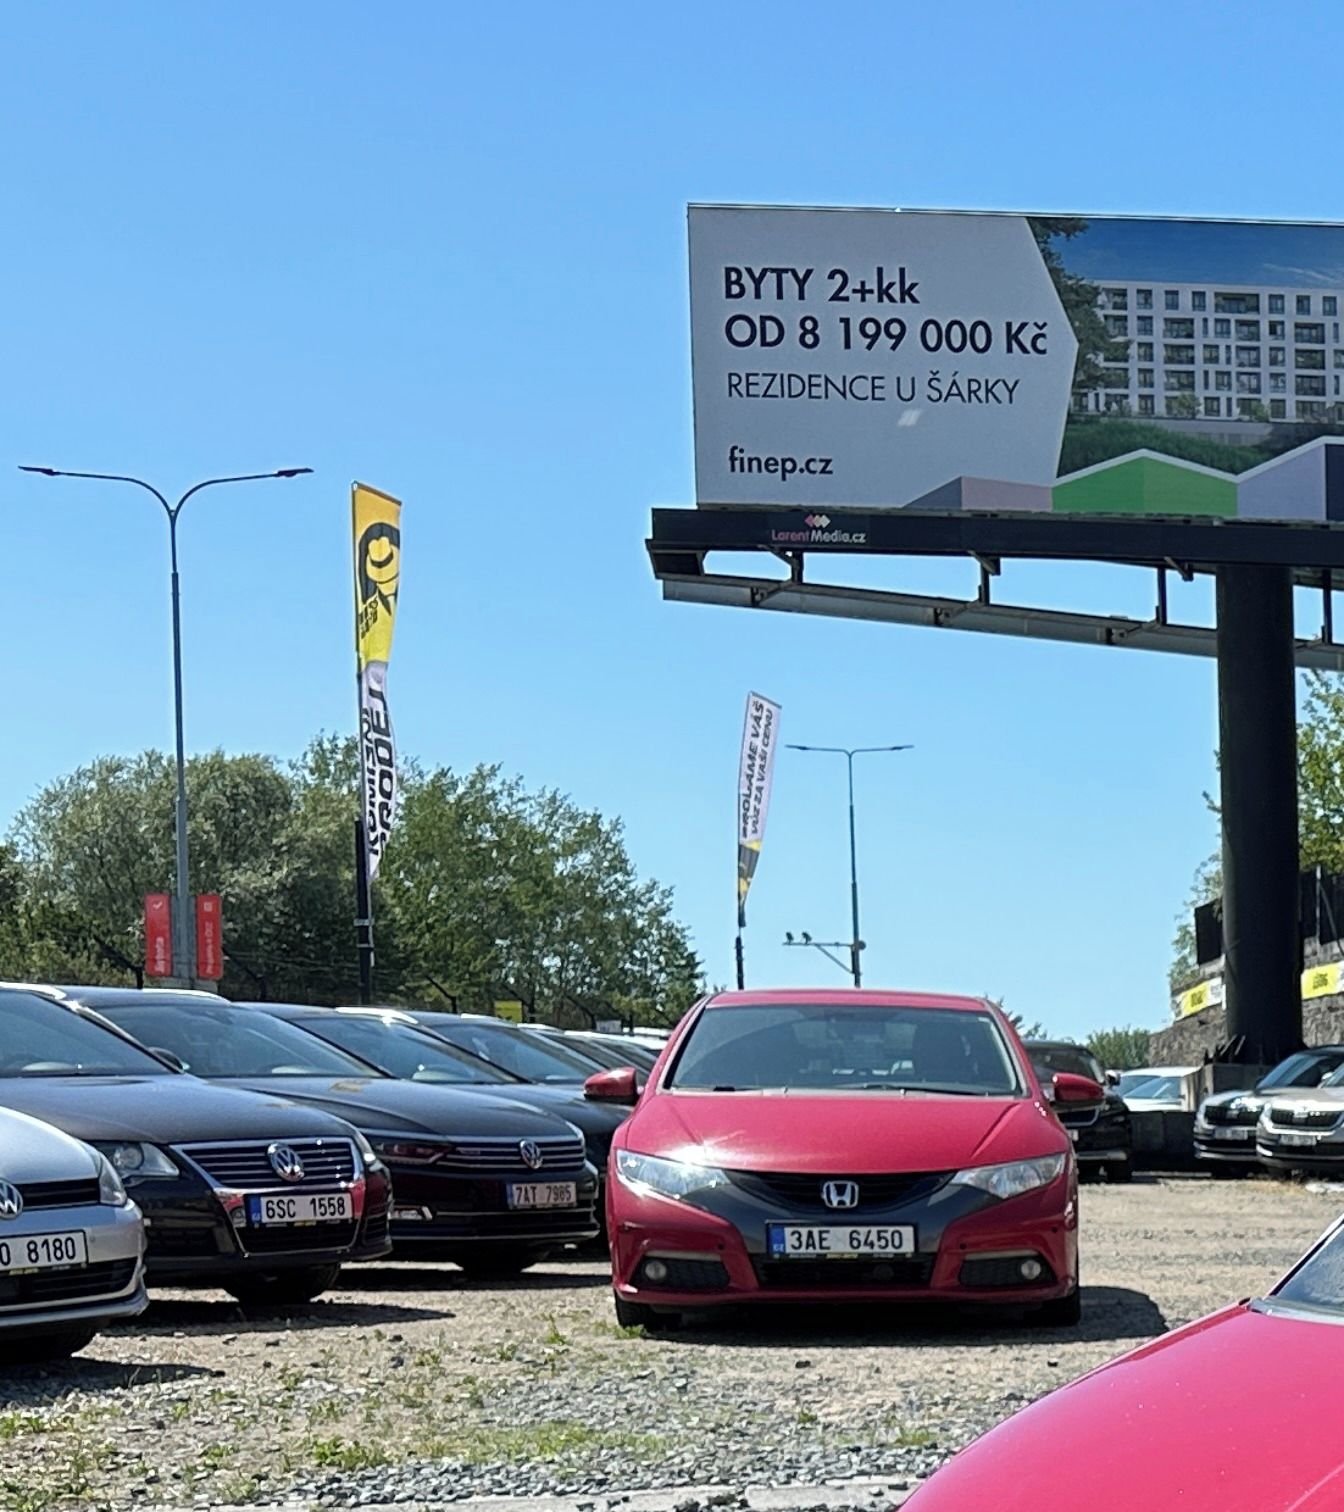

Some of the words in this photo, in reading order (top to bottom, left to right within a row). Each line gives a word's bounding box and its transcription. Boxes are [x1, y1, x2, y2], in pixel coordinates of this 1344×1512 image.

[724, 266, 814, 301] BYTY
[827, 266, 920, 304] 2+kk
[725, 314, 785, 348] OD
[798, 316, 821, 350] 8
[839, 317, 907, 351] 199
[920, 319, 993, 354] 000
[1006, 321, 1048, 355] Kč
[728, 372, 886, 401] REZIDENCE
[897, 376, 916, 401] U
[927, 369, 1020, 404] ŠÁRKY
[729, 445, 833, 481] finep.cz
[771, 529, 867, 544] LarentMedia.cz
[265, 1199, 296, 1219] 6SC
[310, 1196, 346, 1217] 1558
[27, 1237, 76, 1264] 8180
[790, 1229, 831, 1251] 3AE
[849, 1229, 903, 1250] 6450
